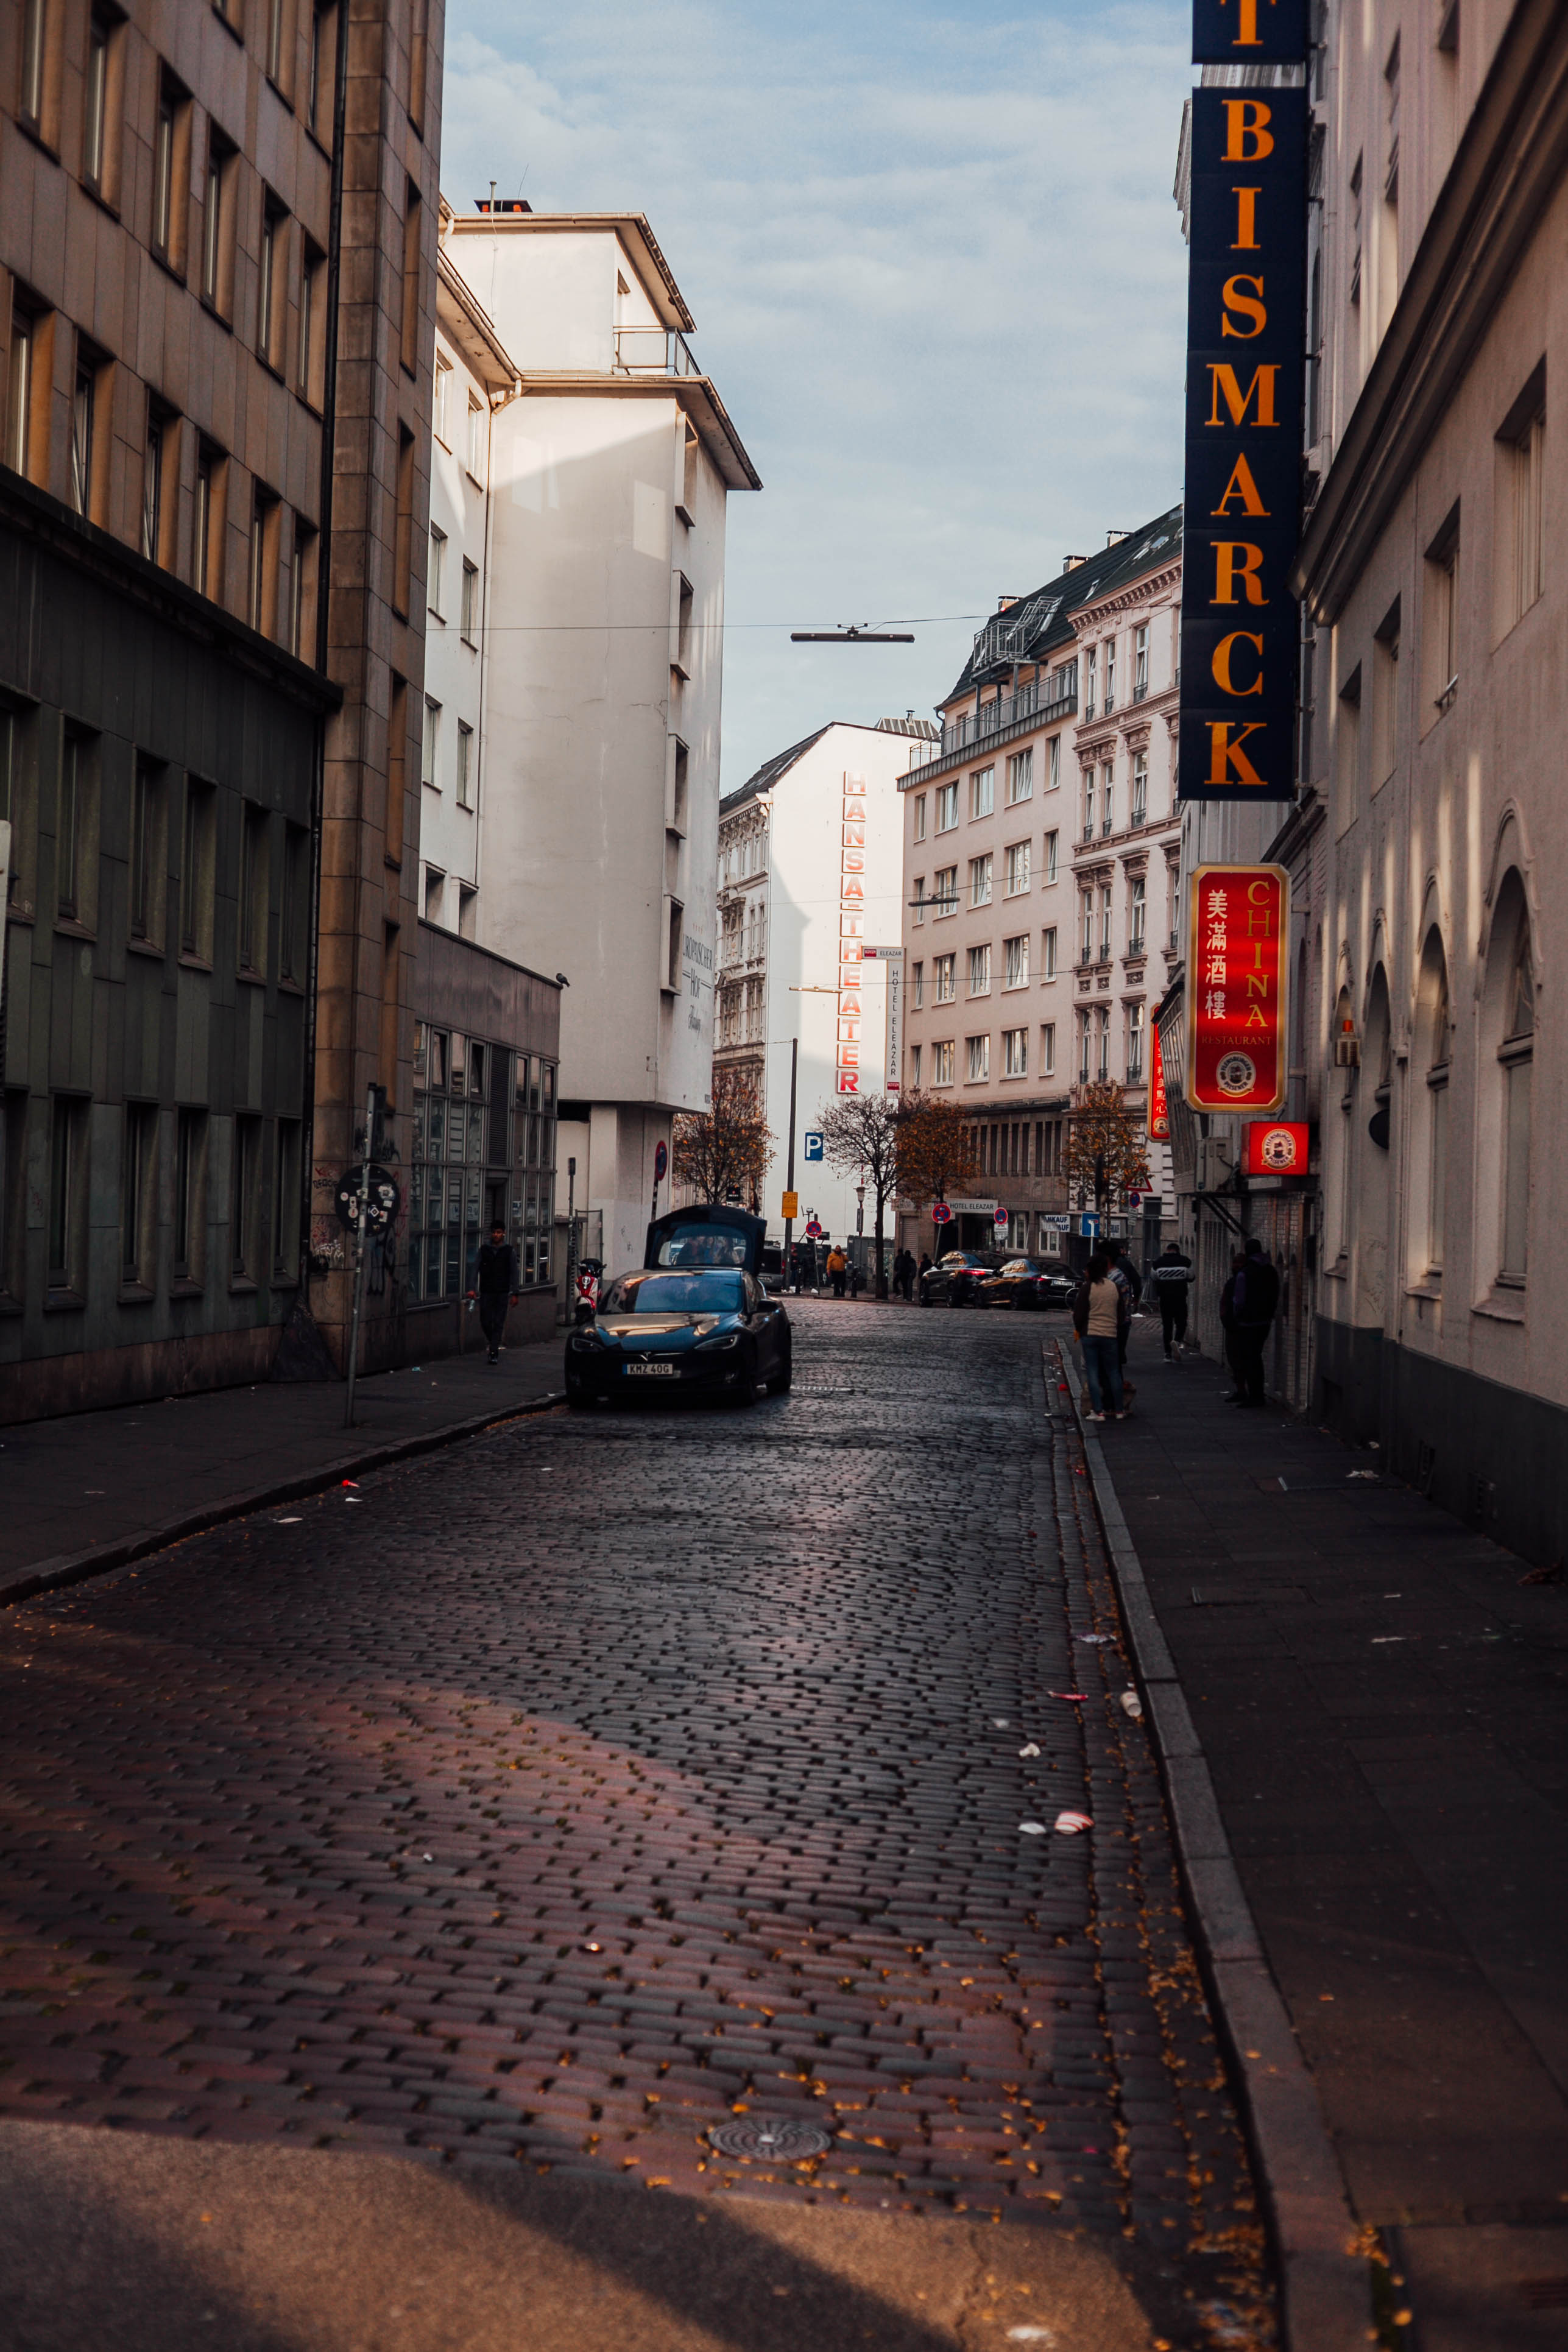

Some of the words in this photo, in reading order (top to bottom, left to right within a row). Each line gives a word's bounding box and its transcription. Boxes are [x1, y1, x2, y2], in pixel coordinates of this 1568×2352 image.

[1204, 99, 1281, 786] BISMARCK
[841, 772, 867, 1093] HANSA-THEATER
[1205, 889, 1228, 1020] 美滿酒樓
[1245, 880, 1271, 1028] CHINA
[1201, 1036, 1272, 1046] RESTAURANT
[807, 1135, 822, 1157] P
